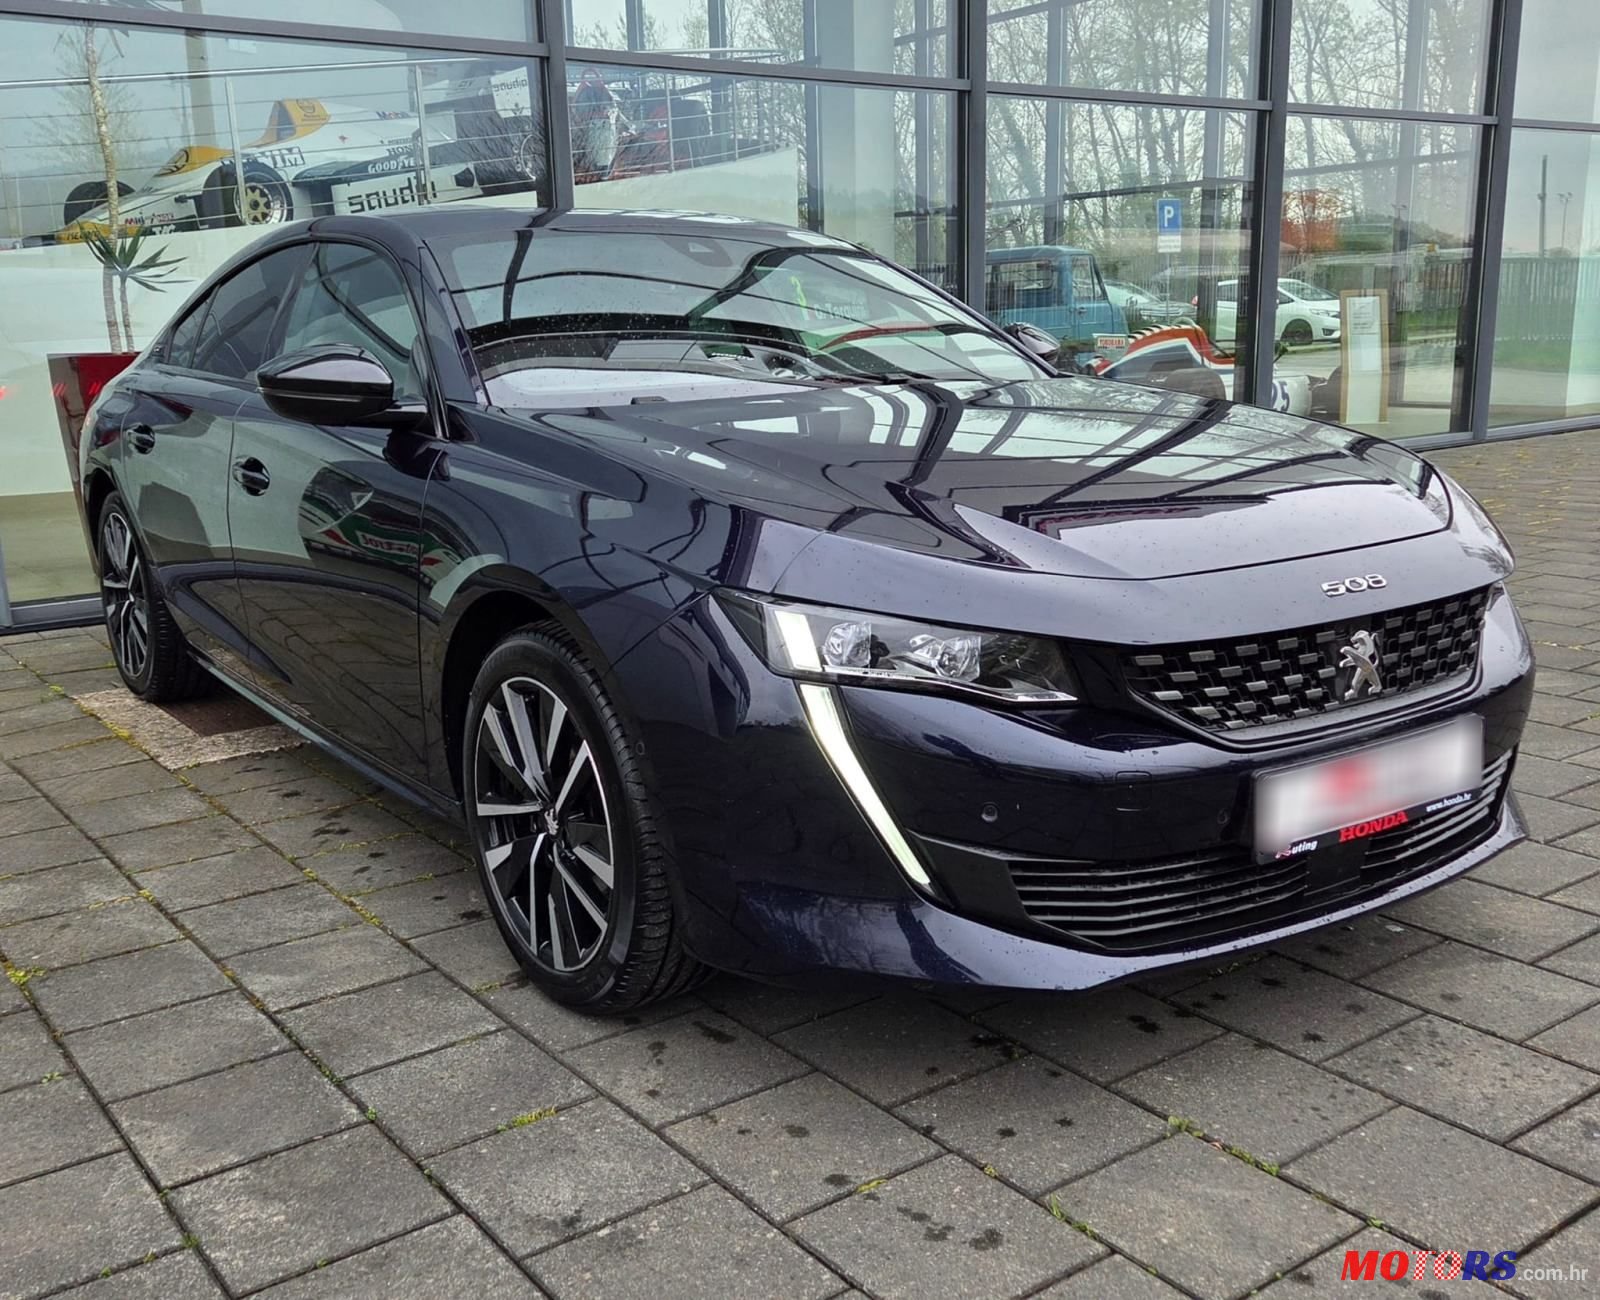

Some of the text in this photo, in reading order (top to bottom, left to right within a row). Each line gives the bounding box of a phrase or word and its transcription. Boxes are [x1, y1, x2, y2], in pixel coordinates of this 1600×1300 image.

[1164, 206, 1175, 227] P
[1321, 573, 1387, 596] 508
[1339, 810, 1409, 842] HONDA
